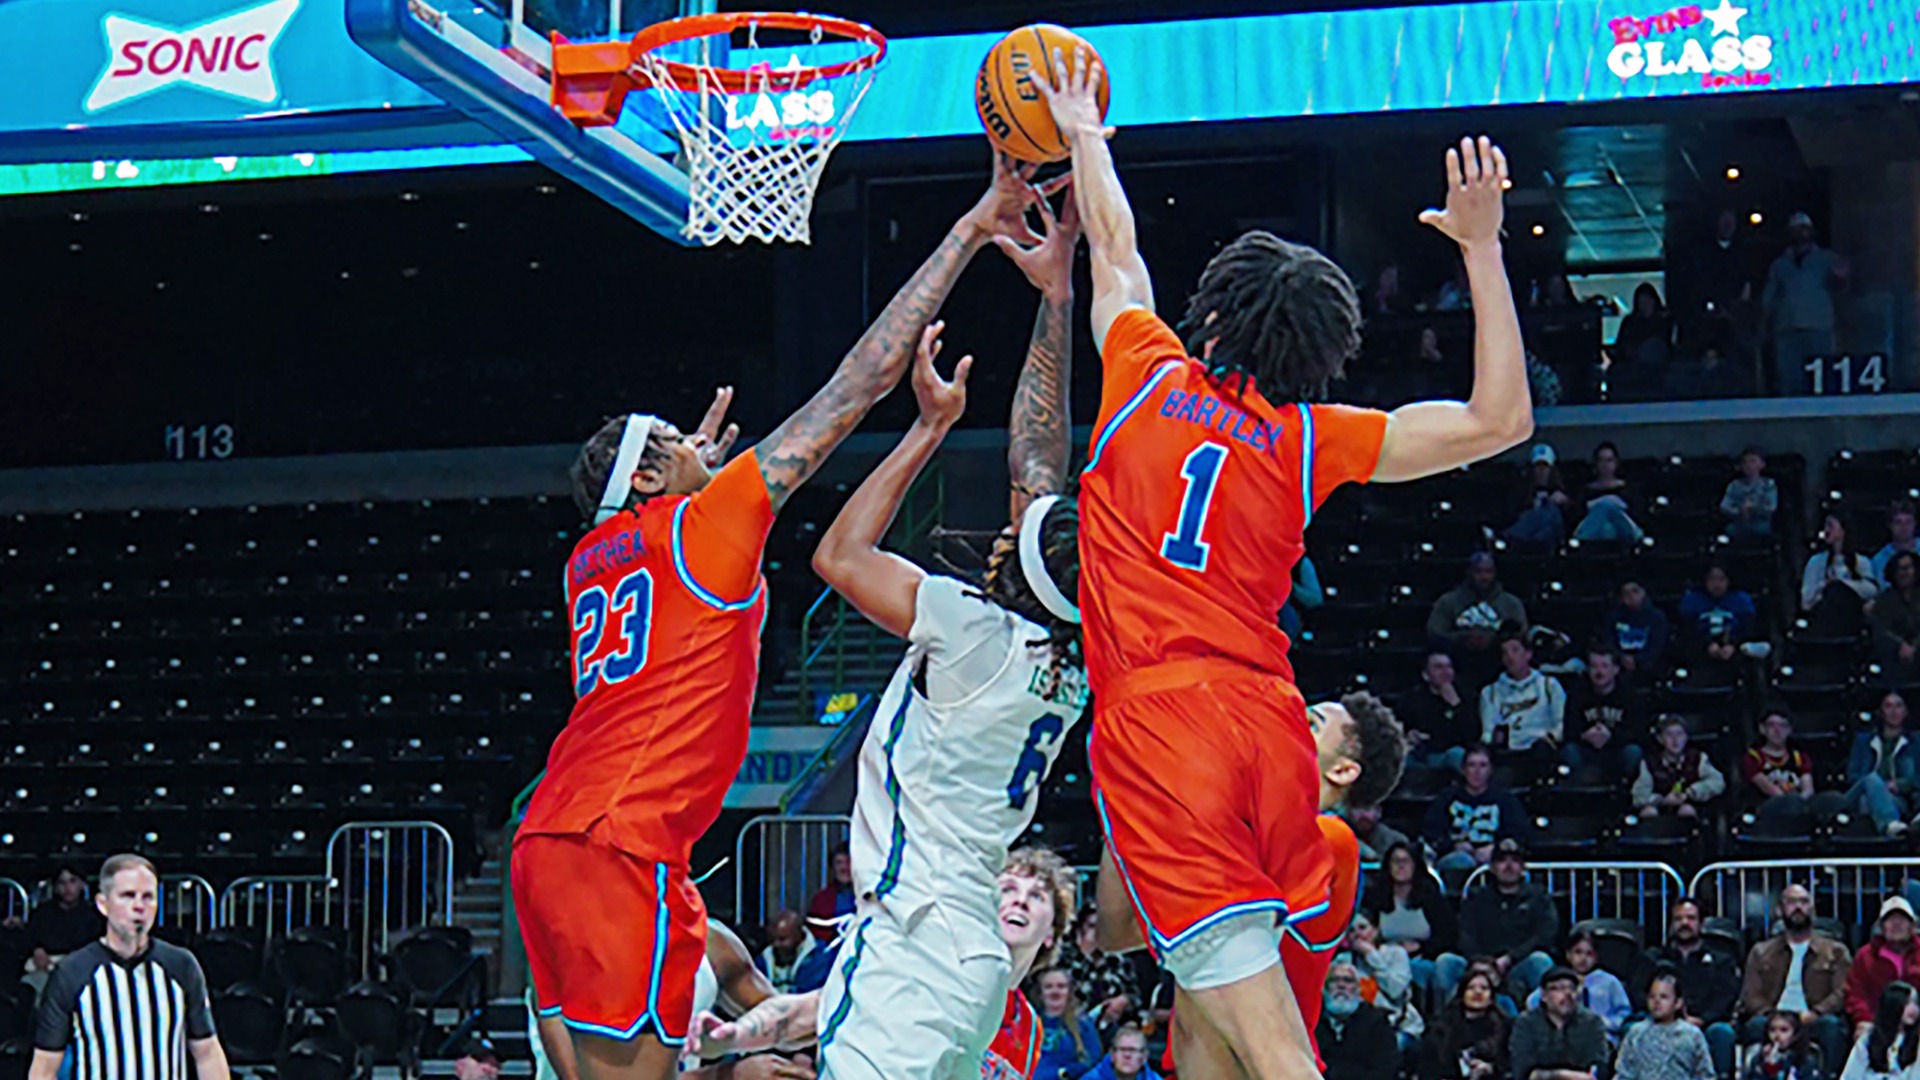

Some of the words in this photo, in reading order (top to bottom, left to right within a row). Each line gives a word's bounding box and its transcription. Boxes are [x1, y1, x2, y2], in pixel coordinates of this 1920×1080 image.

[112, 33, 266, 77] SONIC
[1607, 34, 1773, 78] GLASS
[726, 90, 835, 129] LASS
[1804, 355, 1886, 394] 114
[168, 423, 235, 459] 113
[1159, 387, 1284, 457] BARTLEY
[1159, 440, 1230, 573] 1
[573, 566, 654, 700] 23
[735, 752, 817, 782] ND
[1007, 711, 1064, 811] 6
